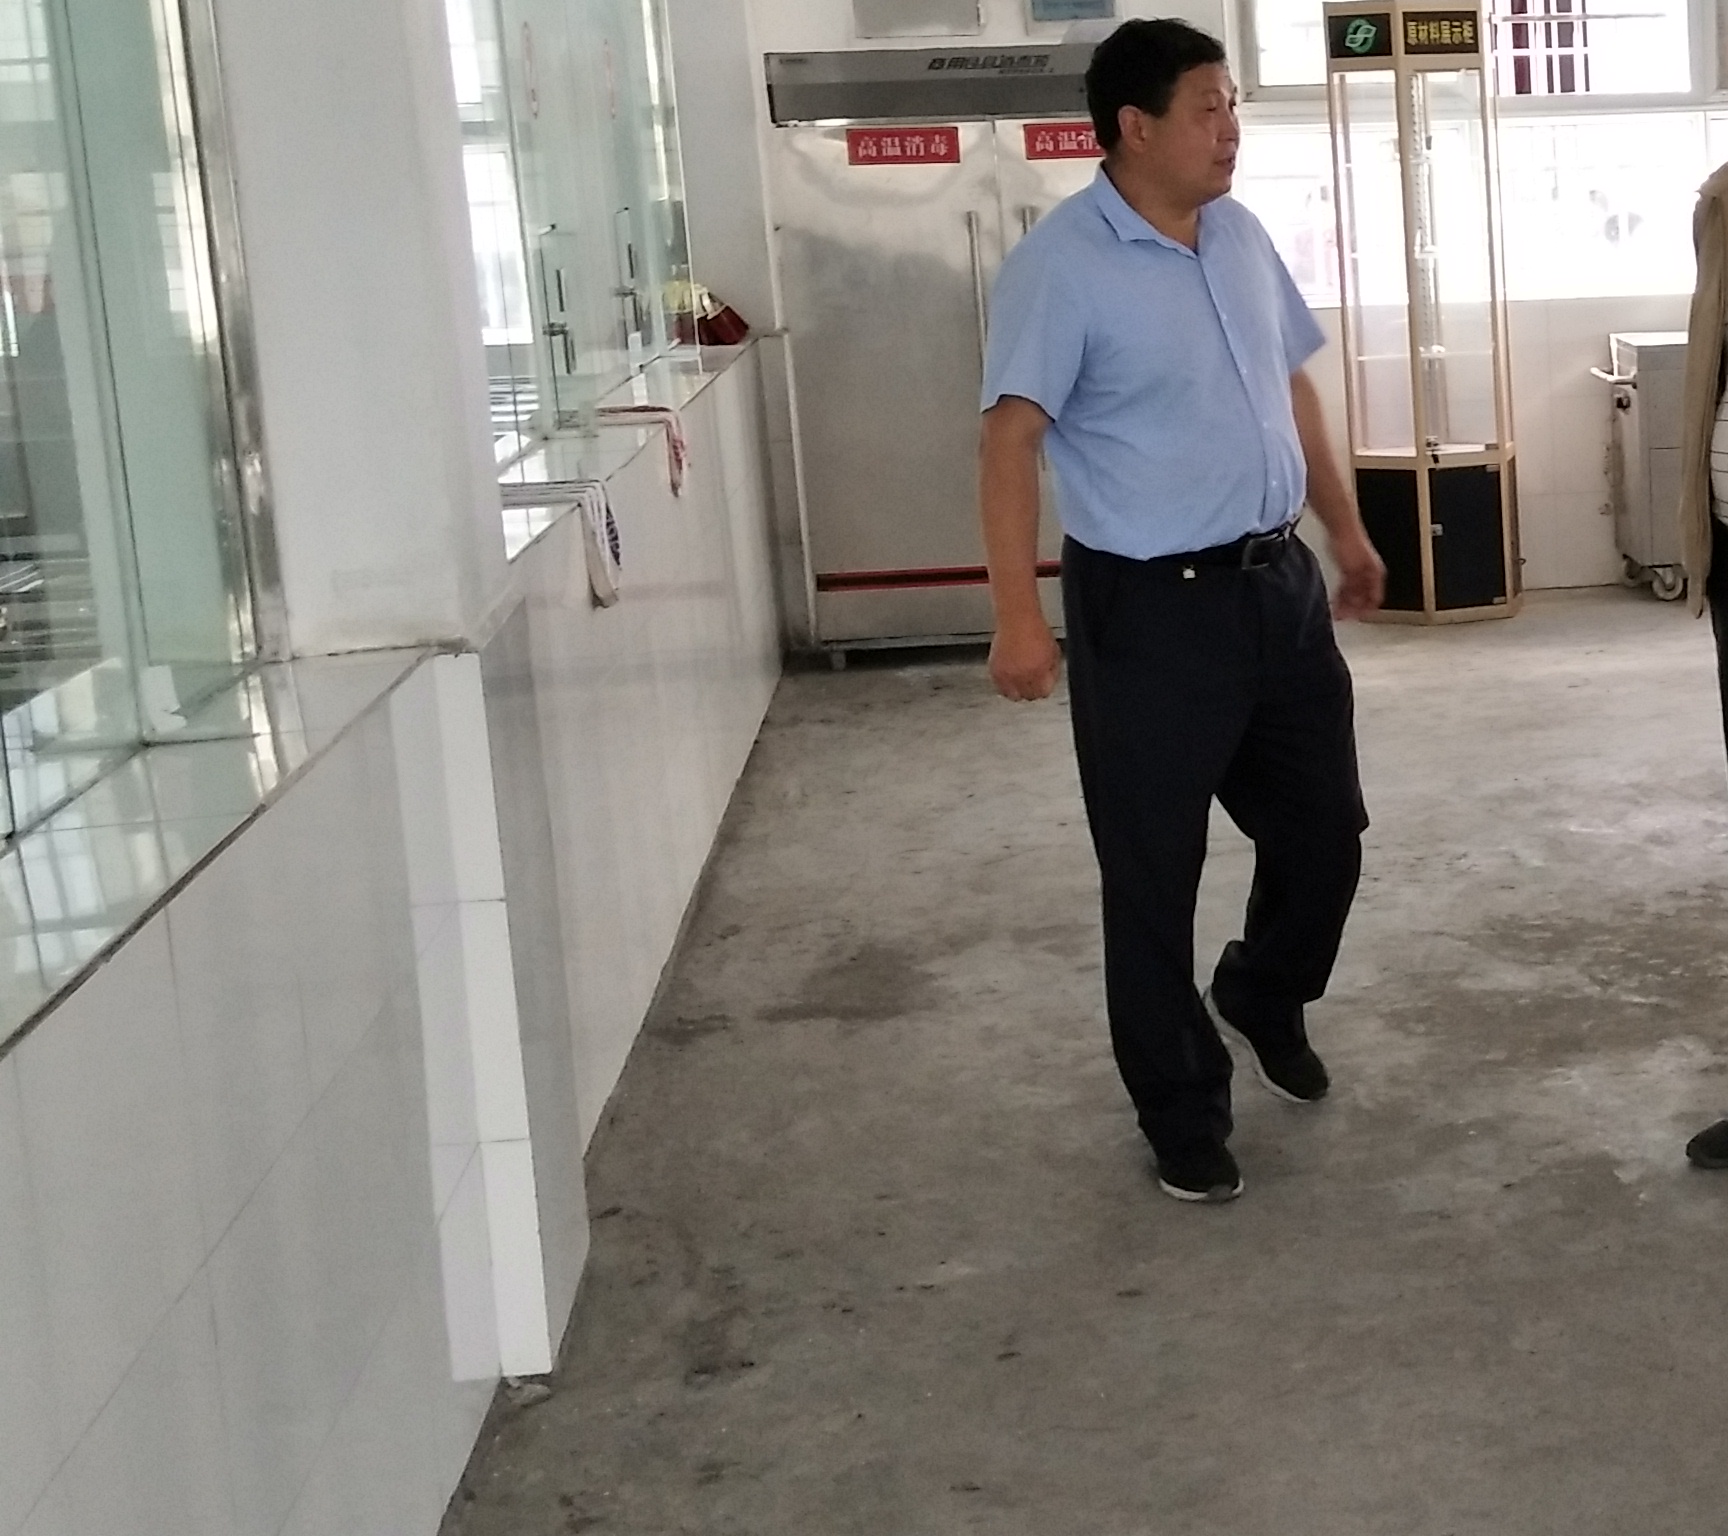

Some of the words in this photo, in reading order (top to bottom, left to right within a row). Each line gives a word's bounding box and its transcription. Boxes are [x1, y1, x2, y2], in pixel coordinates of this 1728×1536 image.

[1407, 21, 1475, 45] 原材料展示柜
[857, 134, 950, 158] 高温消毒
